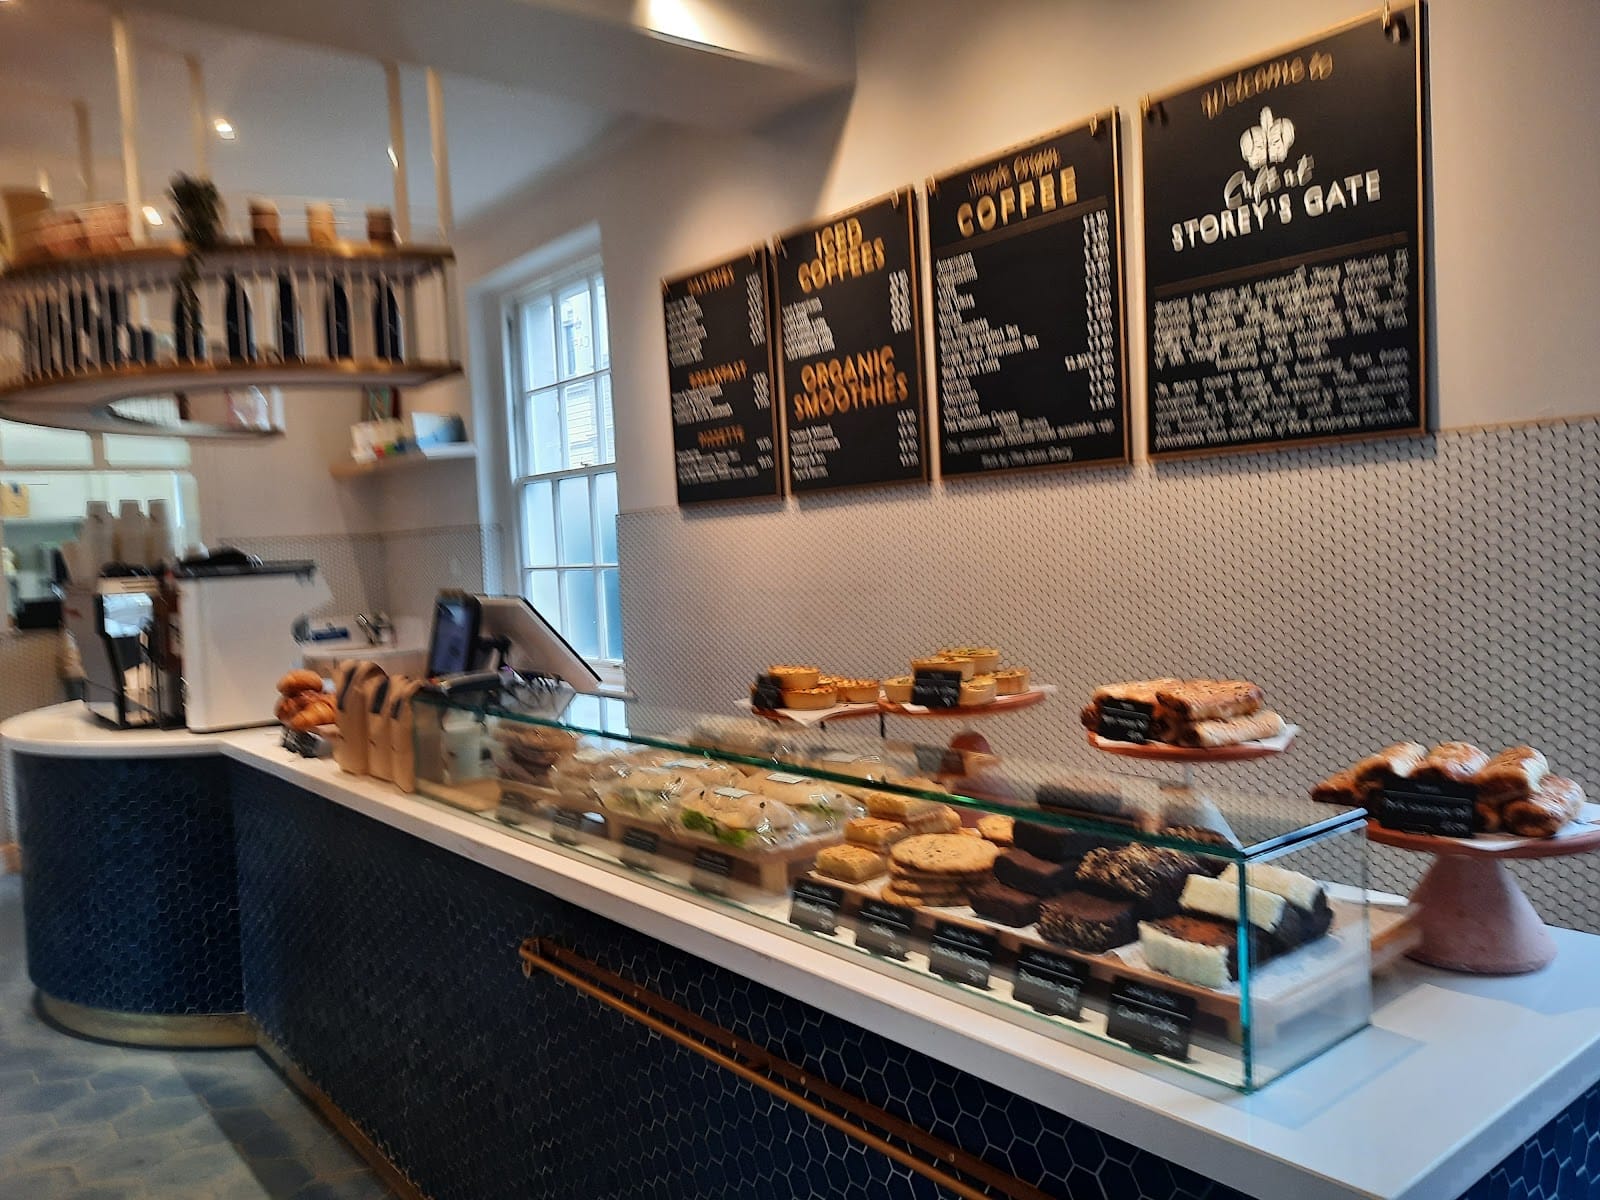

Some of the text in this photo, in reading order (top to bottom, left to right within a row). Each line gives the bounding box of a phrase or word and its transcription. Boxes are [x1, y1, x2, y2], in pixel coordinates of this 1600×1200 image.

[1201, 51, 1333, 120] Welcome to
[957, 165, 1078, 239] COFFEE
[1171, 169, 1381, 252] STOREY'S GATE
[798, 237, 885, 293] COFFEES
[815, 217, 863, 260] ICED
[794, 371, 908, 421] SMOOTHIES
[801, 345, 895, 393] ORGANIC
